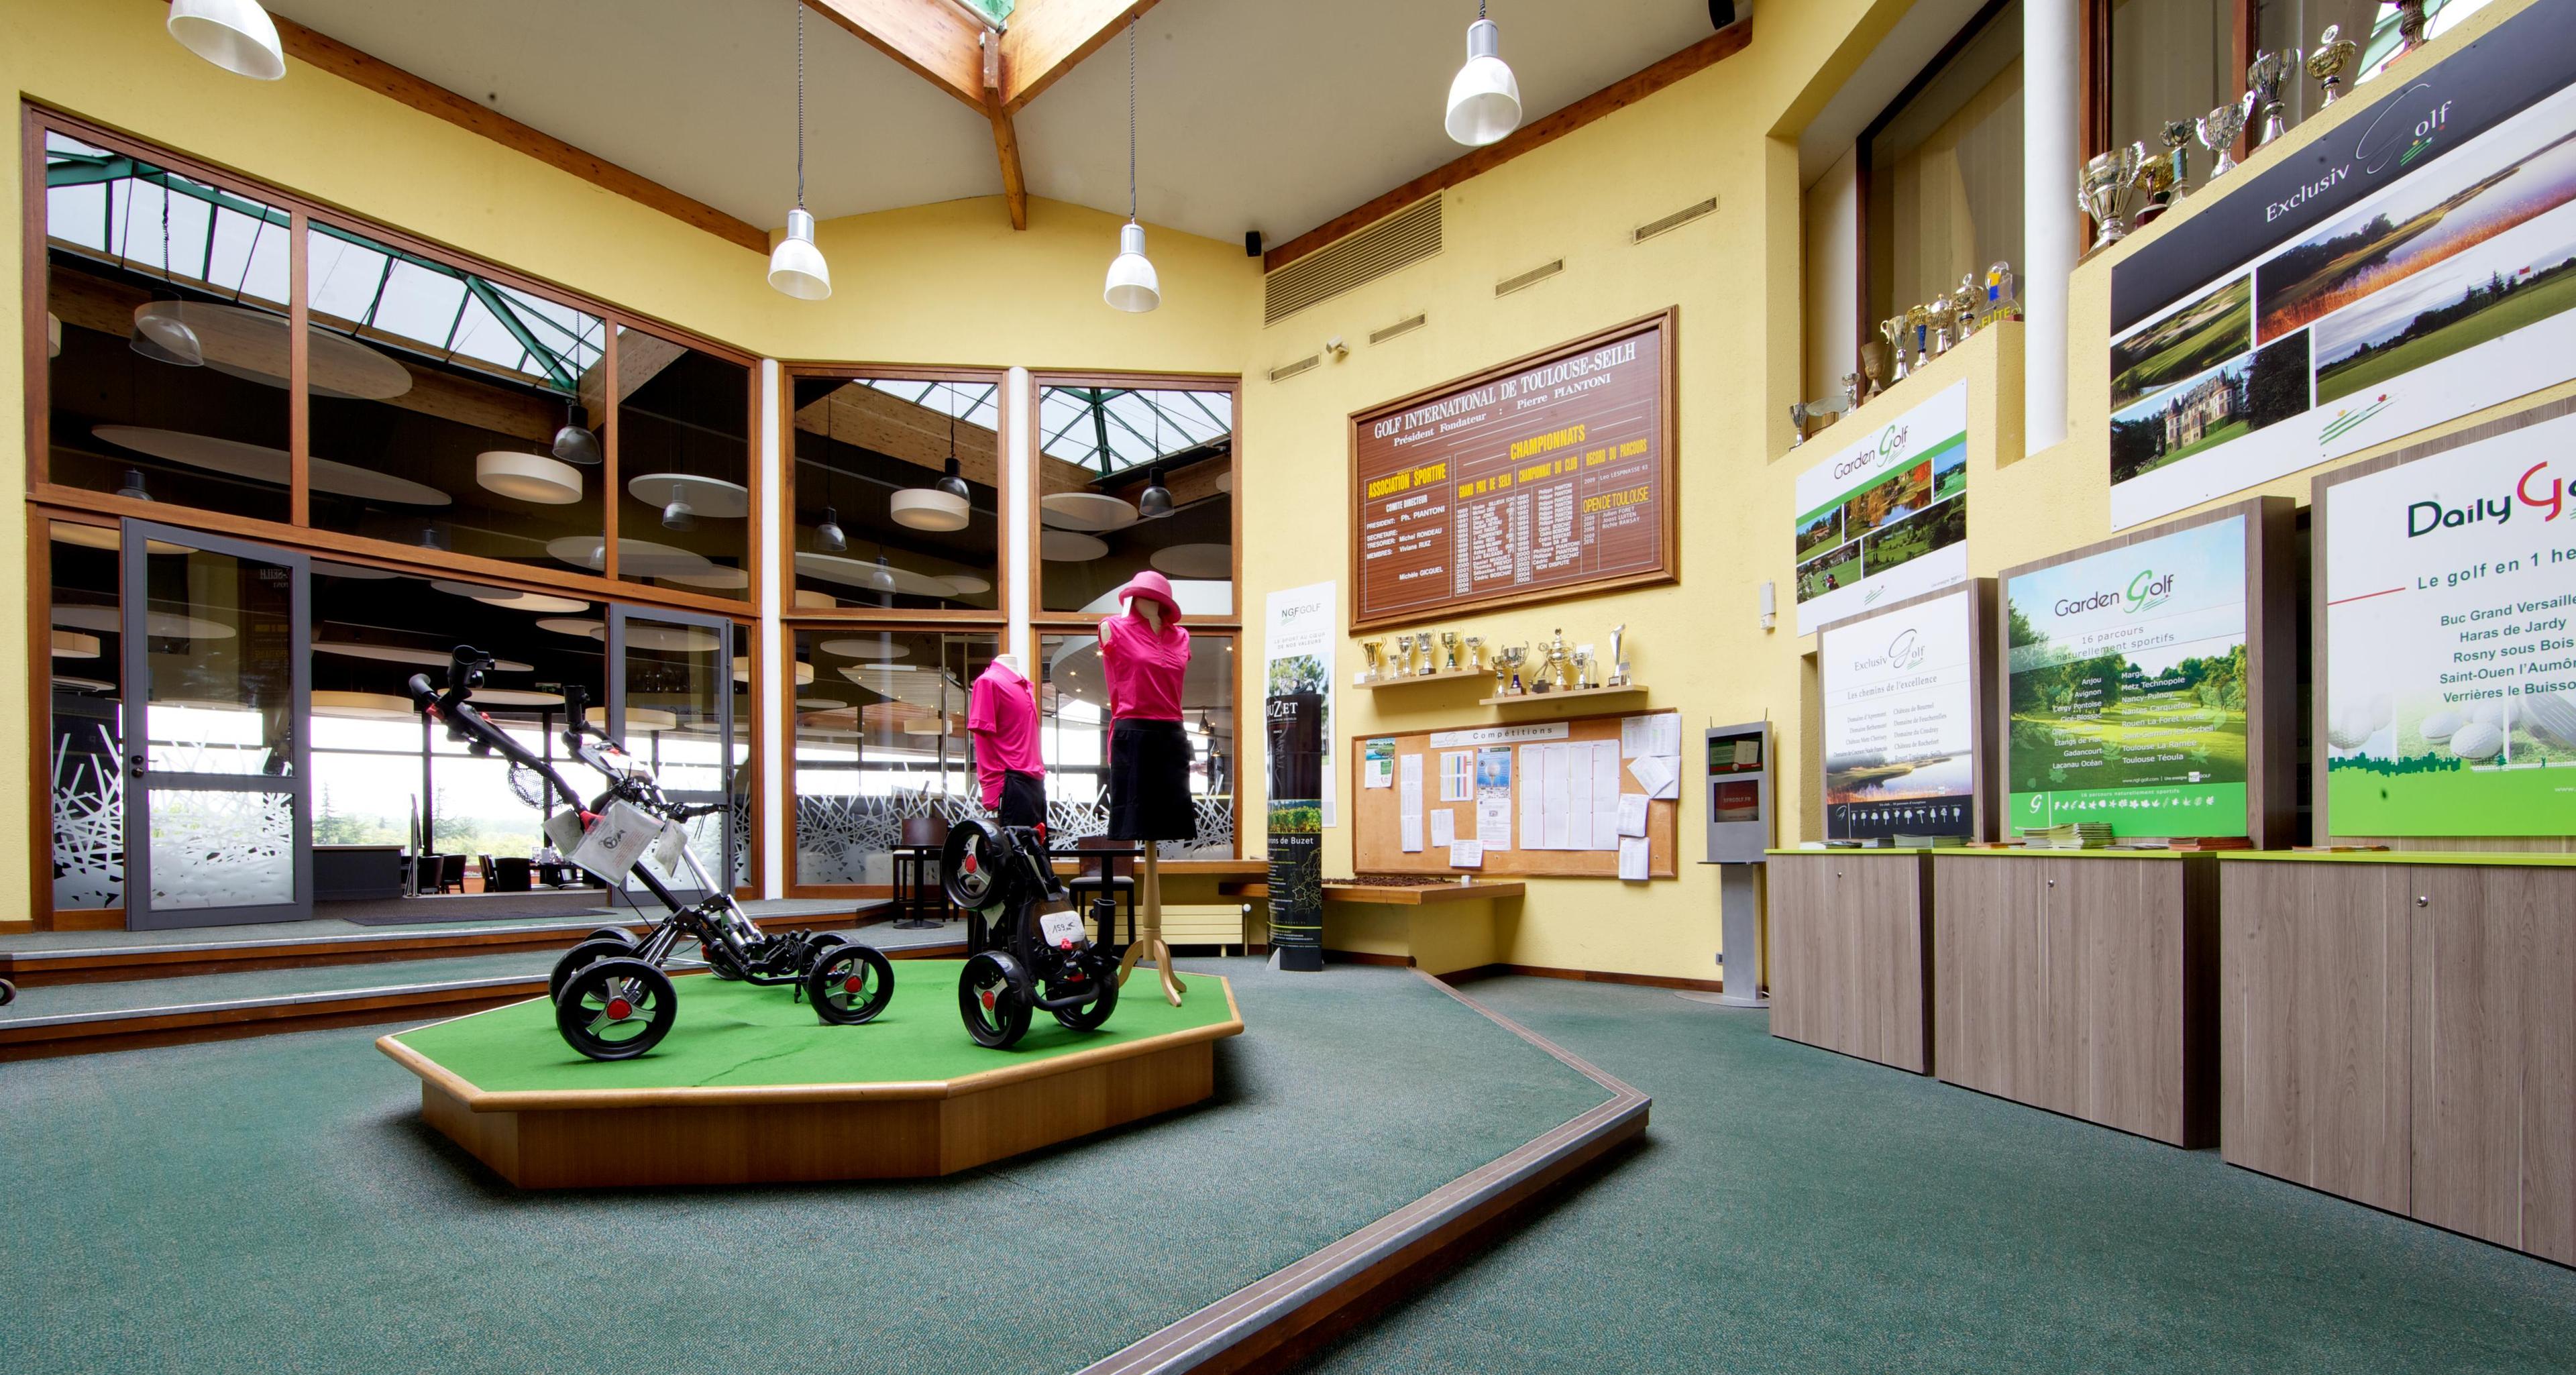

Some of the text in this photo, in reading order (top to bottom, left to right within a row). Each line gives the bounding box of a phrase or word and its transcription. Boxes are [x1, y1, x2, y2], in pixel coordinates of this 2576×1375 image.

[2265, 164, 2350, 223] Exclusiv
[1375, 341, 1636, 439] GOLF INTERNATIONAL DE TOULOUSE-SEILH
[1393, 428, 1435, 447] Président
[1440, 413, 1487, 433] Fondateur
[1517, 394, 1548, 410] Pierre
[1554, 373, 1611, 398] PIANTONI
[1511, 424, 1586, 460] CHAMPIONNATS
[1586, 438, 1647, 466] RECORD DU PARCOURS
[1834, 425, 1909, 480] Garden Golf
[1565, 456, 1577, 472] CLUB
[1368, 463, 1446, 499] ASSOCIATION SPORTIVE
[1499, 473, 1511, 488] SEILH
[1583, 486, 1649, 513] OPEN DE TOULOUSE
[1366, 518, 1395, 530] PRESIDENT:
[1413, 505, 1445, 518] PIANTONI
[2408, 496, 2511, 538] Daily
[1417, 527, 1442, 539] RONDEAU
[2418, 576, 2438, 590] Le
[2447, 563, 2487, 587] golf
[2496, 560, 2519, 574] en
[2530, 552, 2538, 567] 1
[2055, 569, 2174, 616] Garden Golf
[2440, 614, 2466, 626] Buc
[2470, 604, 2512, 621] Grand
[2082, 626, 2144, 644] 16 parcours
[2460, 618, 2567, 643] Haras de Jardy
[2056, 633, 2174, 661] naturellement sportifs
[2453, 637, 2575, 663] Rosny sous Bois
[1854, 656, 1887, 671] Exclusiv
[2082, 677, 2102, 686] Anjou
[2141, 676, 2186, 689] Technopole
[2440, 667, 2514, 684] Saint-Ouen
[1847, 675, 1937, 700] Les chemins de l'excellence
[2074, 689, 2102, 698] Avignon
[2443, 688, 2504, 703] Verrières
[2508, 685, 2520, 696] le
[2074, 701, 2102, 710] Pontoise
[2122, 692, 2174, 704] Nancy-Pulnoy
[2122, 702, 2192, 716] Nantes Carquefou
[1473, 727, 1553, 739] Compétitions
[2122, 720, 2145, 728] Rouen
[2063, 747, 2102, 757] Gadancourt
[2123, 744, 2155, 752] Toulouse
[2169, 739, 2197, 748] Ramée
[2053, 759, 2102, 769] Lacanau Océan
[2123, 752, 2184, 764] Toulouse Téoula
[1291, 836, 1313, 844] Buzet
